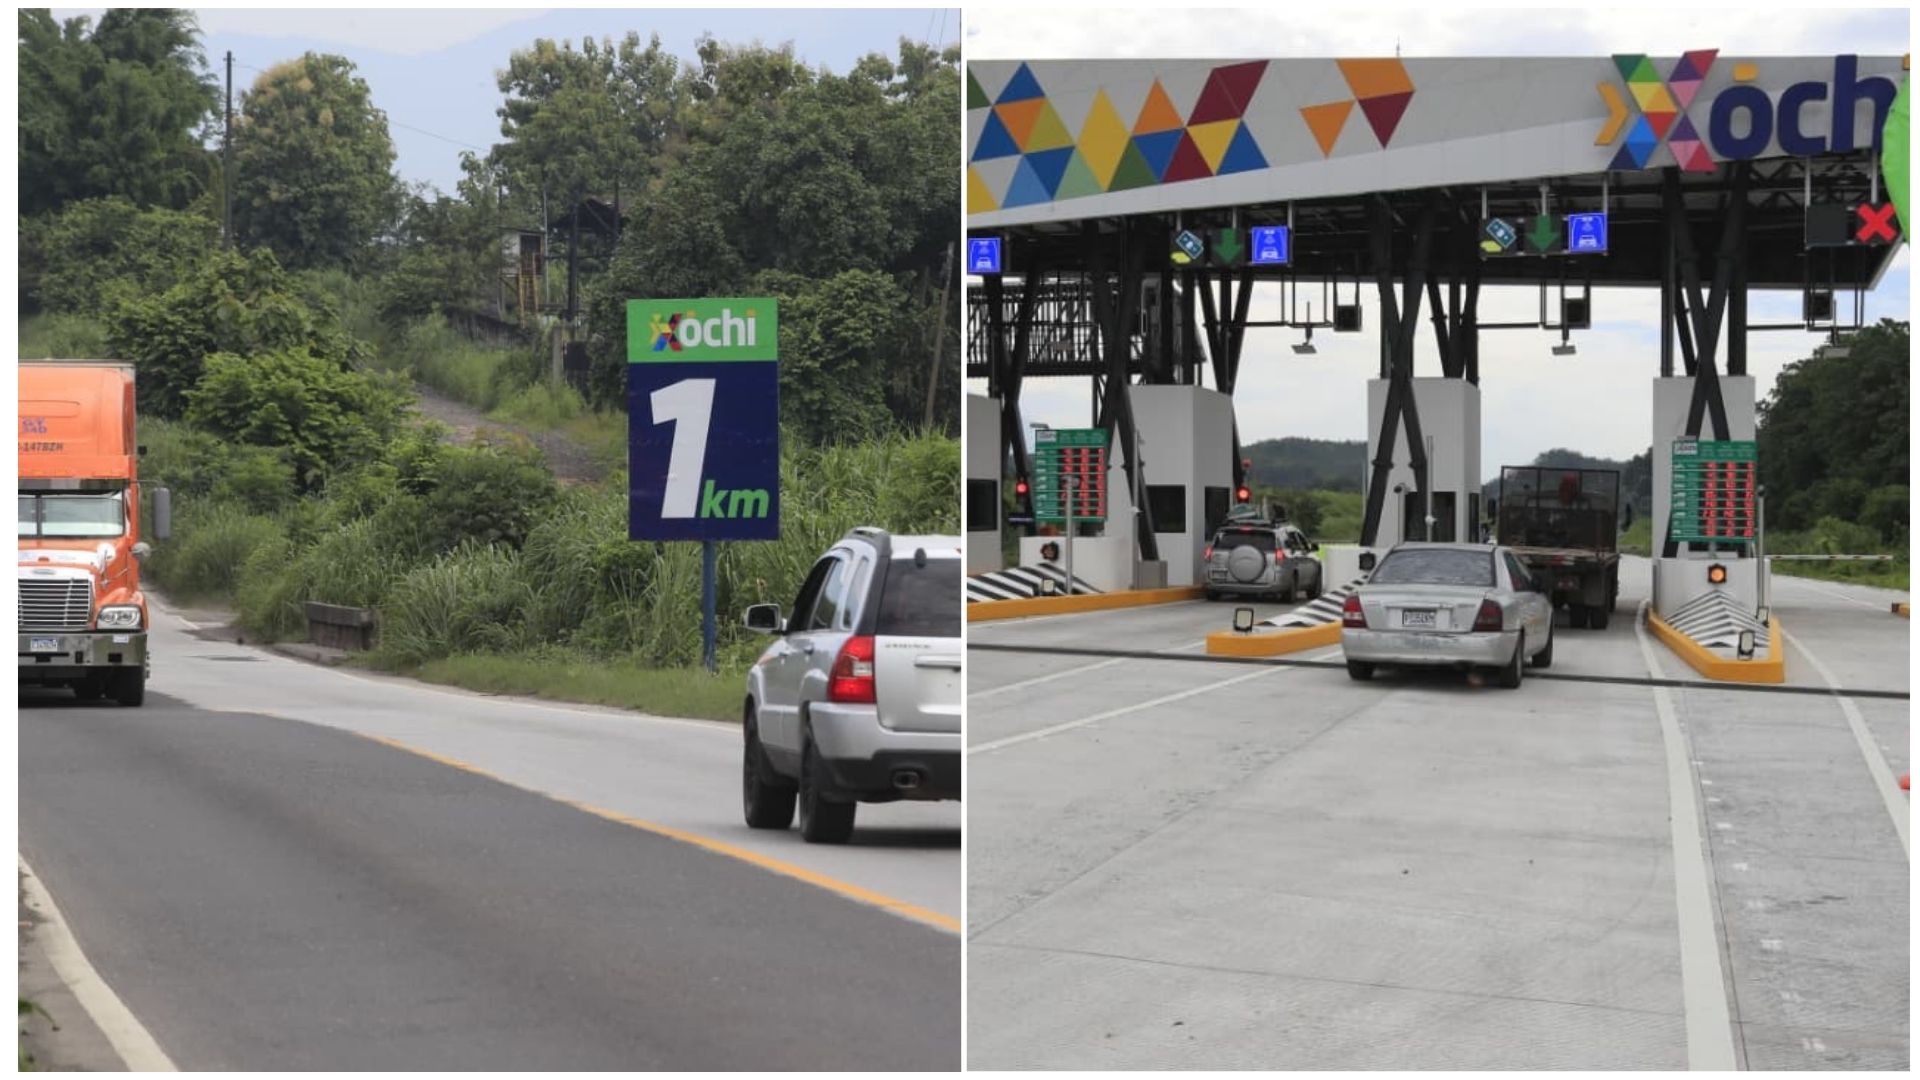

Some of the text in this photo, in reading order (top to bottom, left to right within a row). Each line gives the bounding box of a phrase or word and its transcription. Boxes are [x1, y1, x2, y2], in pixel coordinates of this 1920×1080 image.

[1597, 48, 1909, 172] Xoch
[649, 378, 769, 519] 1 km
